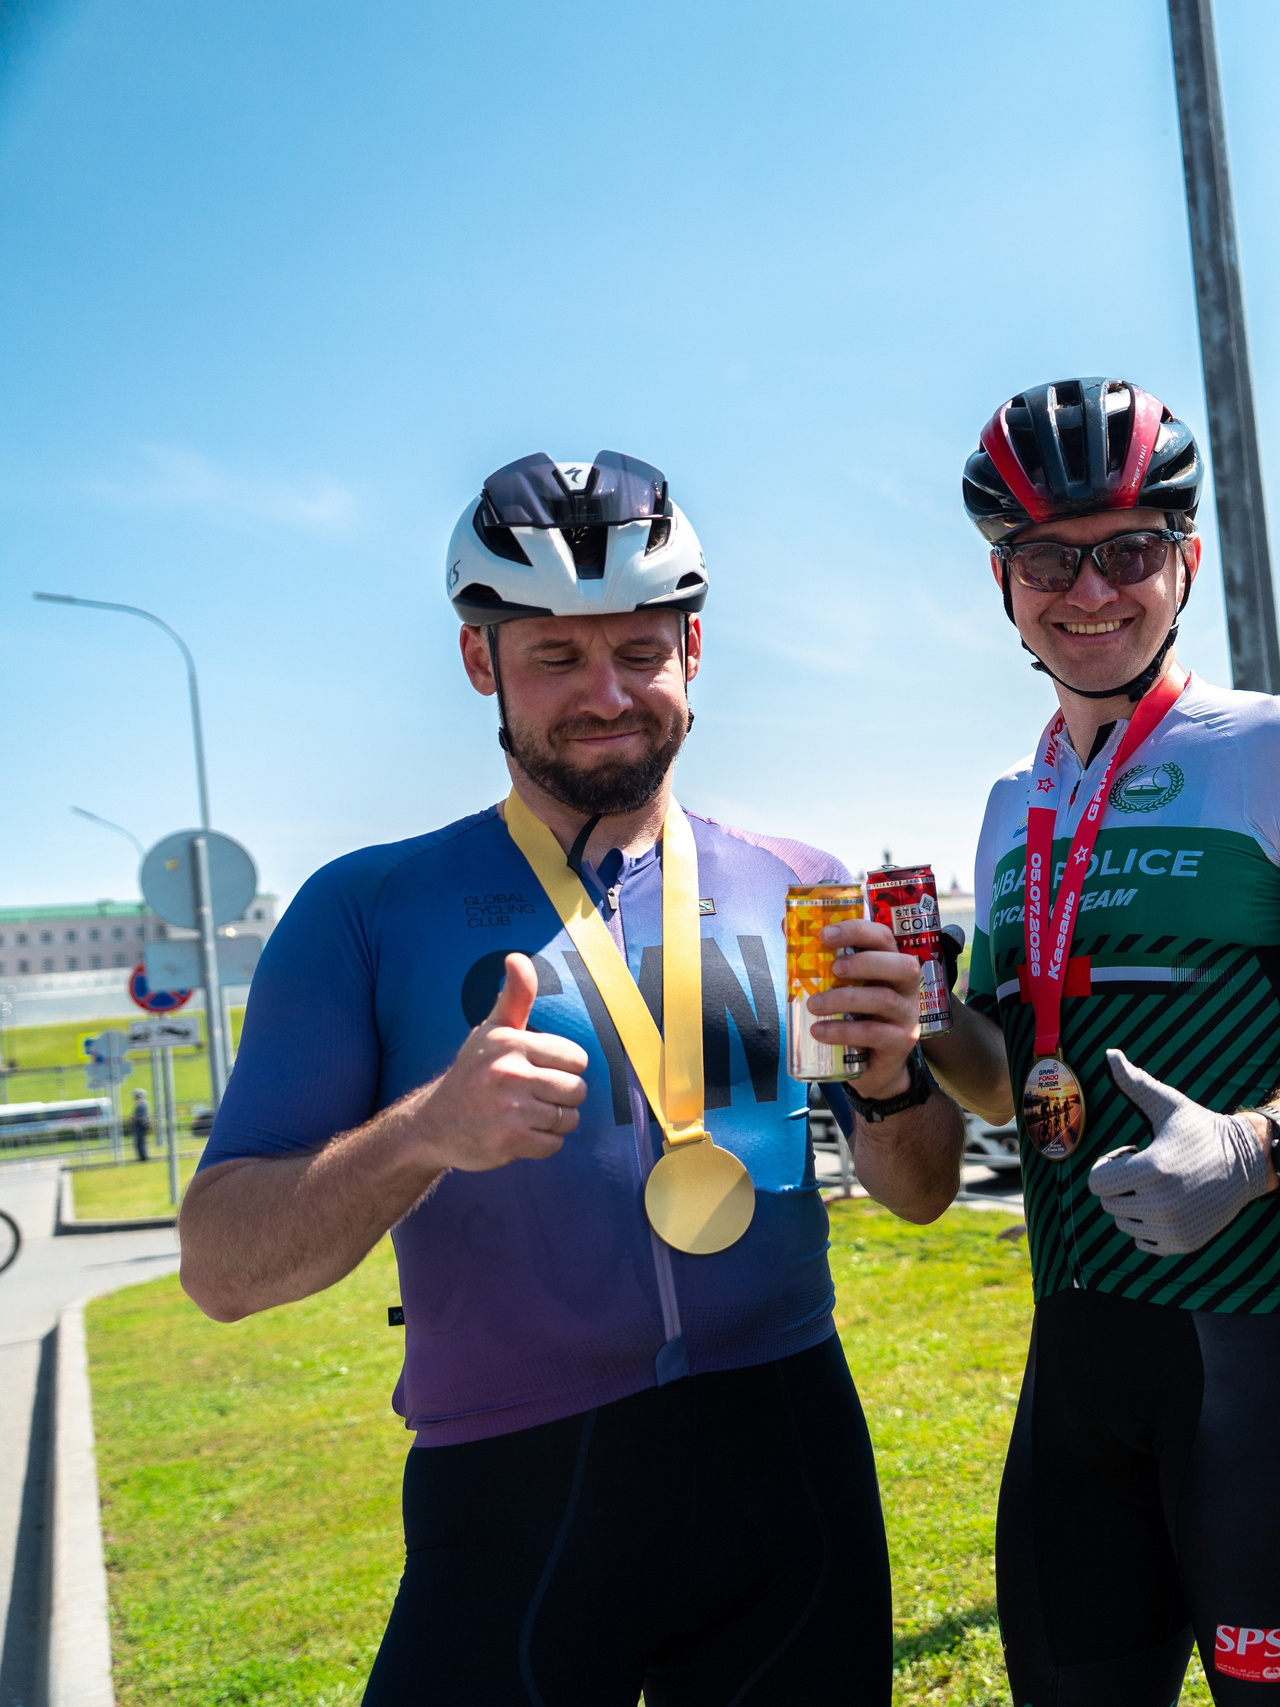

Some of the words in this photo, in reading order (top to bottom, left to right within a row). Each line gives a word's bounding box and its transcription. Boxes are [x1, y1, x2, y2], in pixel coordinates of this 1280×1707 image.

[987, 864, 1027, 907] DUBA
[463, 893, 529, 906] GLOBAL
[1079, 888, 1139, 913] EAM
[465, 904, 536, 917] CYCLING
[1029, 852, 1042, 977] 05.07.2026
[467, 916, 512, 929] CLUB
[900, 916, 939, 932] COLA
[1047, 891, 1076, 981] Казань
